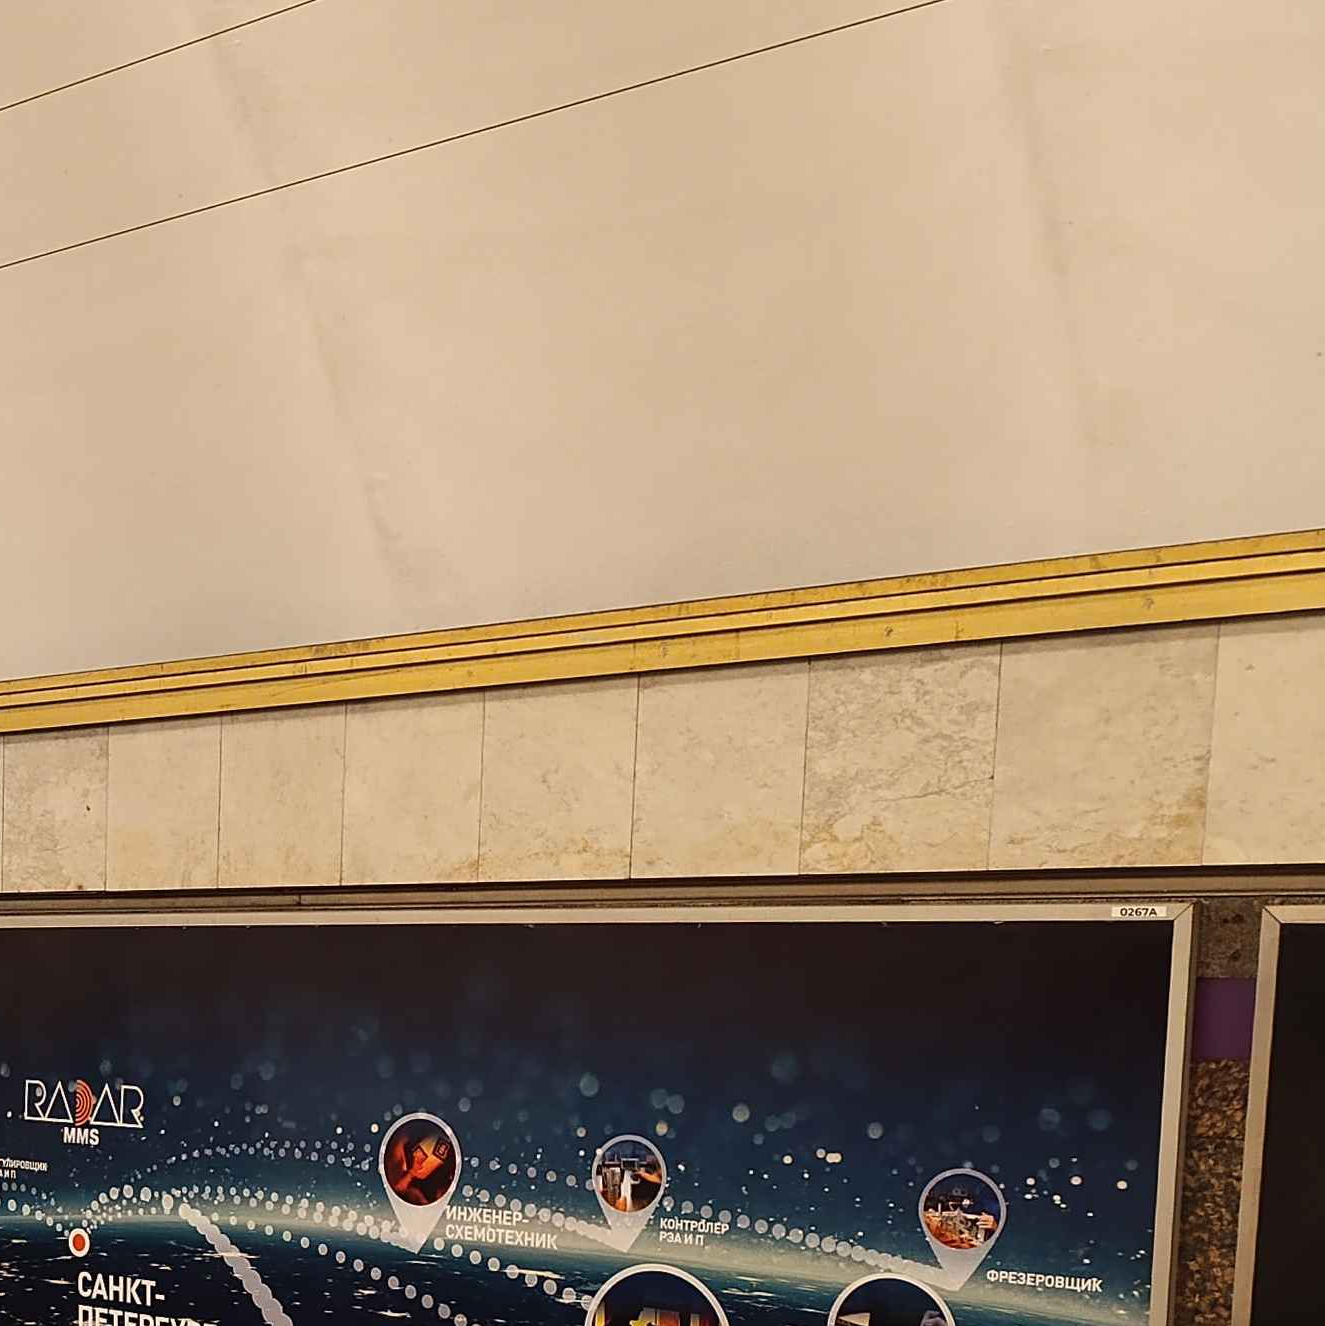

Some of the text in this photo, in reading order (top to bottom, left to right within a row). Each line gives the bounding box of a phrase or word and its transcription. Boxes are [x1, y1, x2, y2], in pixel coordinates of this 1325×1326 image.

[24, 1079, 144, 1128] RADAR
[63, 1126, 100, 1146] MMS
[445, 1205, 530, 1227] ИНЖЕНЕР-
[444, 1223, 558, 1251] СХЕМОТЕХНИК
[659, 1231, 705, 1247] РЭА И П
[77, 1271, 165, 1306] САНКТ-
[986, 1268, 1103, 1294] ФРЕЗЕРОВЩИК
